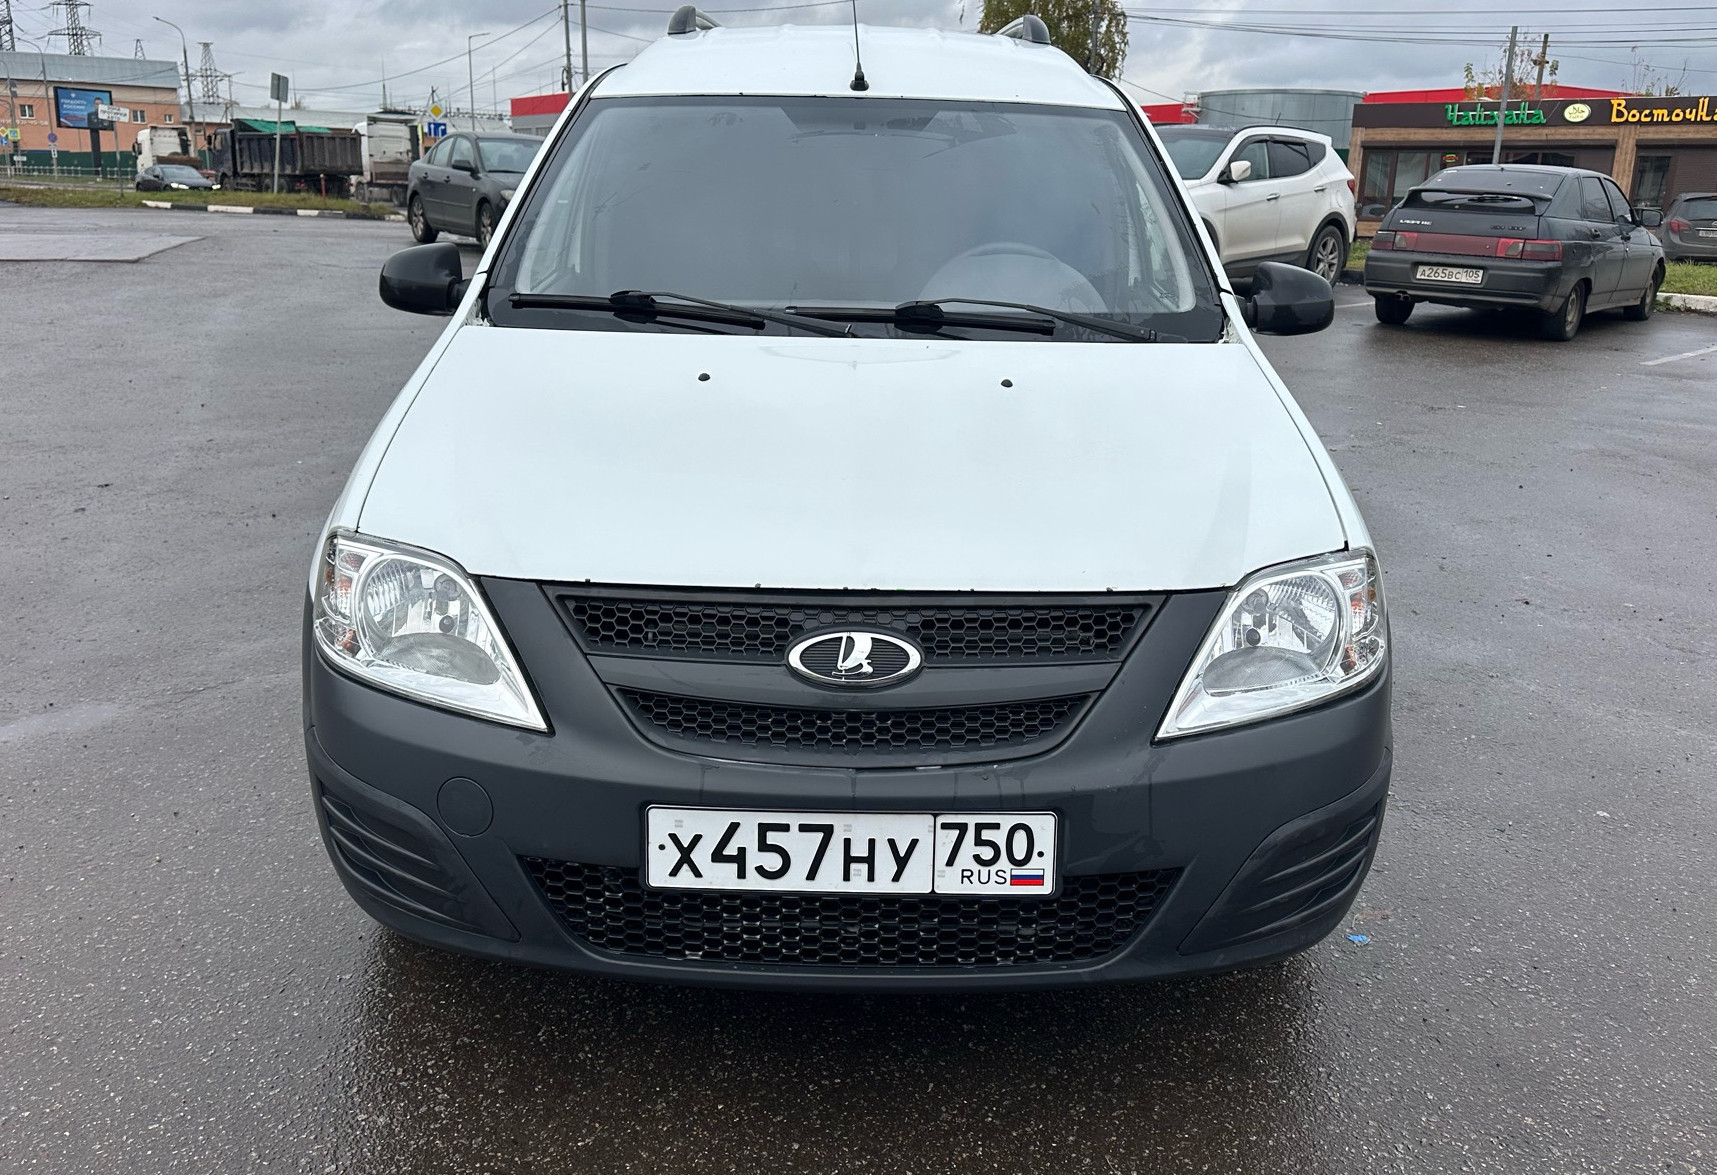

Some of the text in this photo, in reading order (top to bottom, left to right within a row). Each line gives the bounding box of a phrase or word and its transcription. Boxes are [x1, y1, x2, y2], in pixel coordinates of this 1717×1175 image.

[1610, 97, 1717, 123] Восточн
[1463, 270, 1480, 279] 105
[668, 821, 1035, 882] Х457НУ 750
[960, 868, 1008, 885] RUS
